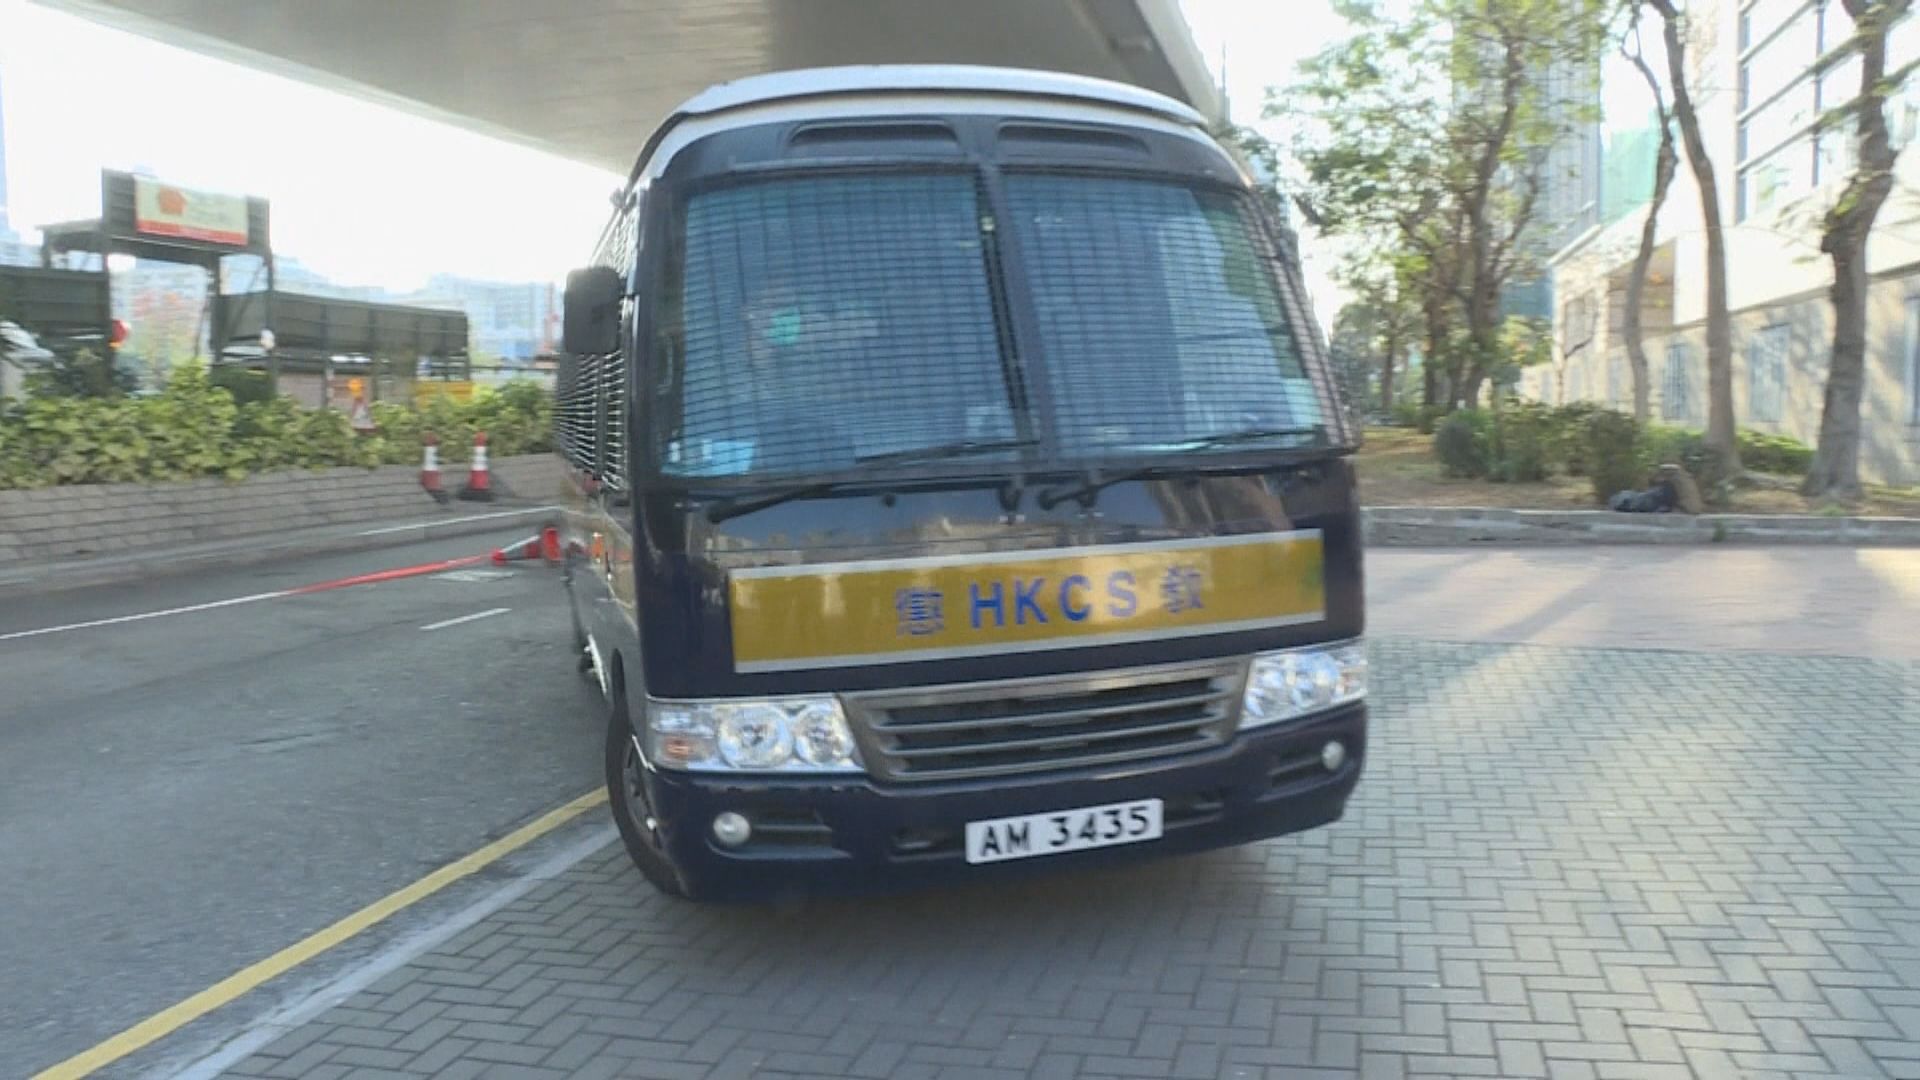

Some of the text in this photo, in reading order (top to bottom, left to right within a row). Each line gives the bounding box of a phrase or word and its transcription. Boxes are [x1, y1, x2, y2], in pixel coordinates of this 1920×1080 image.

[968, 570, 1138, 630] HKCS
[980, 806, 1150, 857] AM 3435
